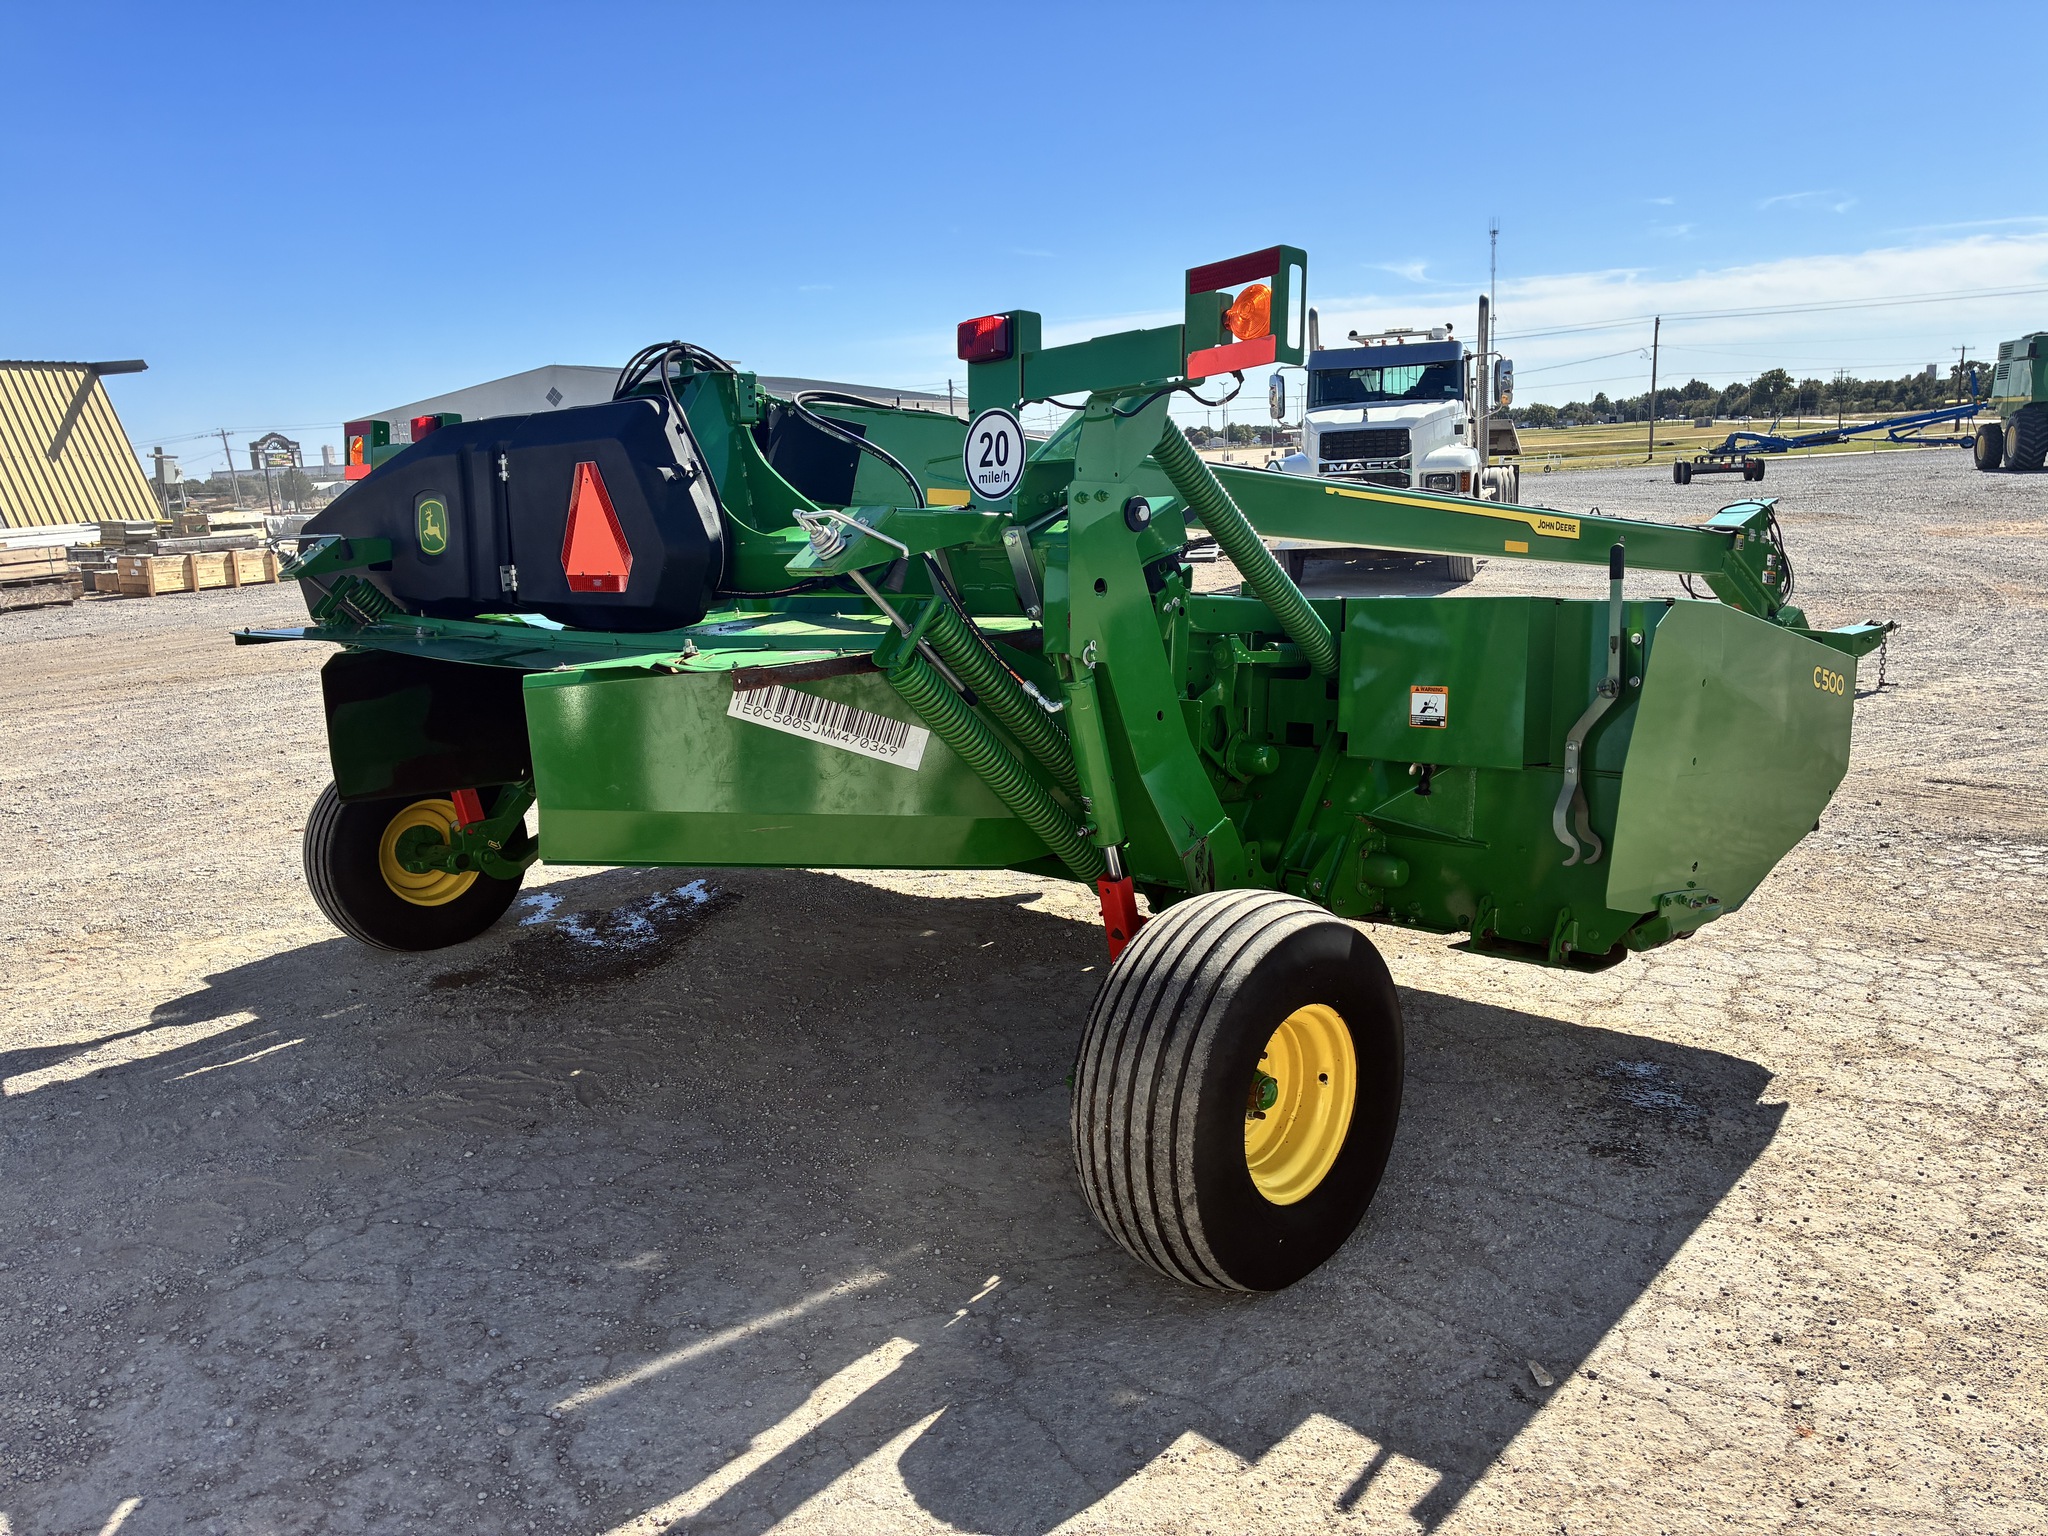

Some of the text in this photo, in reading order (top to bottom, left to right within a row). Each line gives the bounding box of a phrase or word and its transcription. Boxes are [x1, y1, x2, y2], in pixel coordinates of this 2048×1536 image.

[979, 430, 1009, 468] 20
[1329, 461, 1400, 472] MACK
[979, 470, 1010, 484] mile/h
[1537, 519, 1577, 533] JOHN DEERE
[1813, 665, 1845, 697] C500
